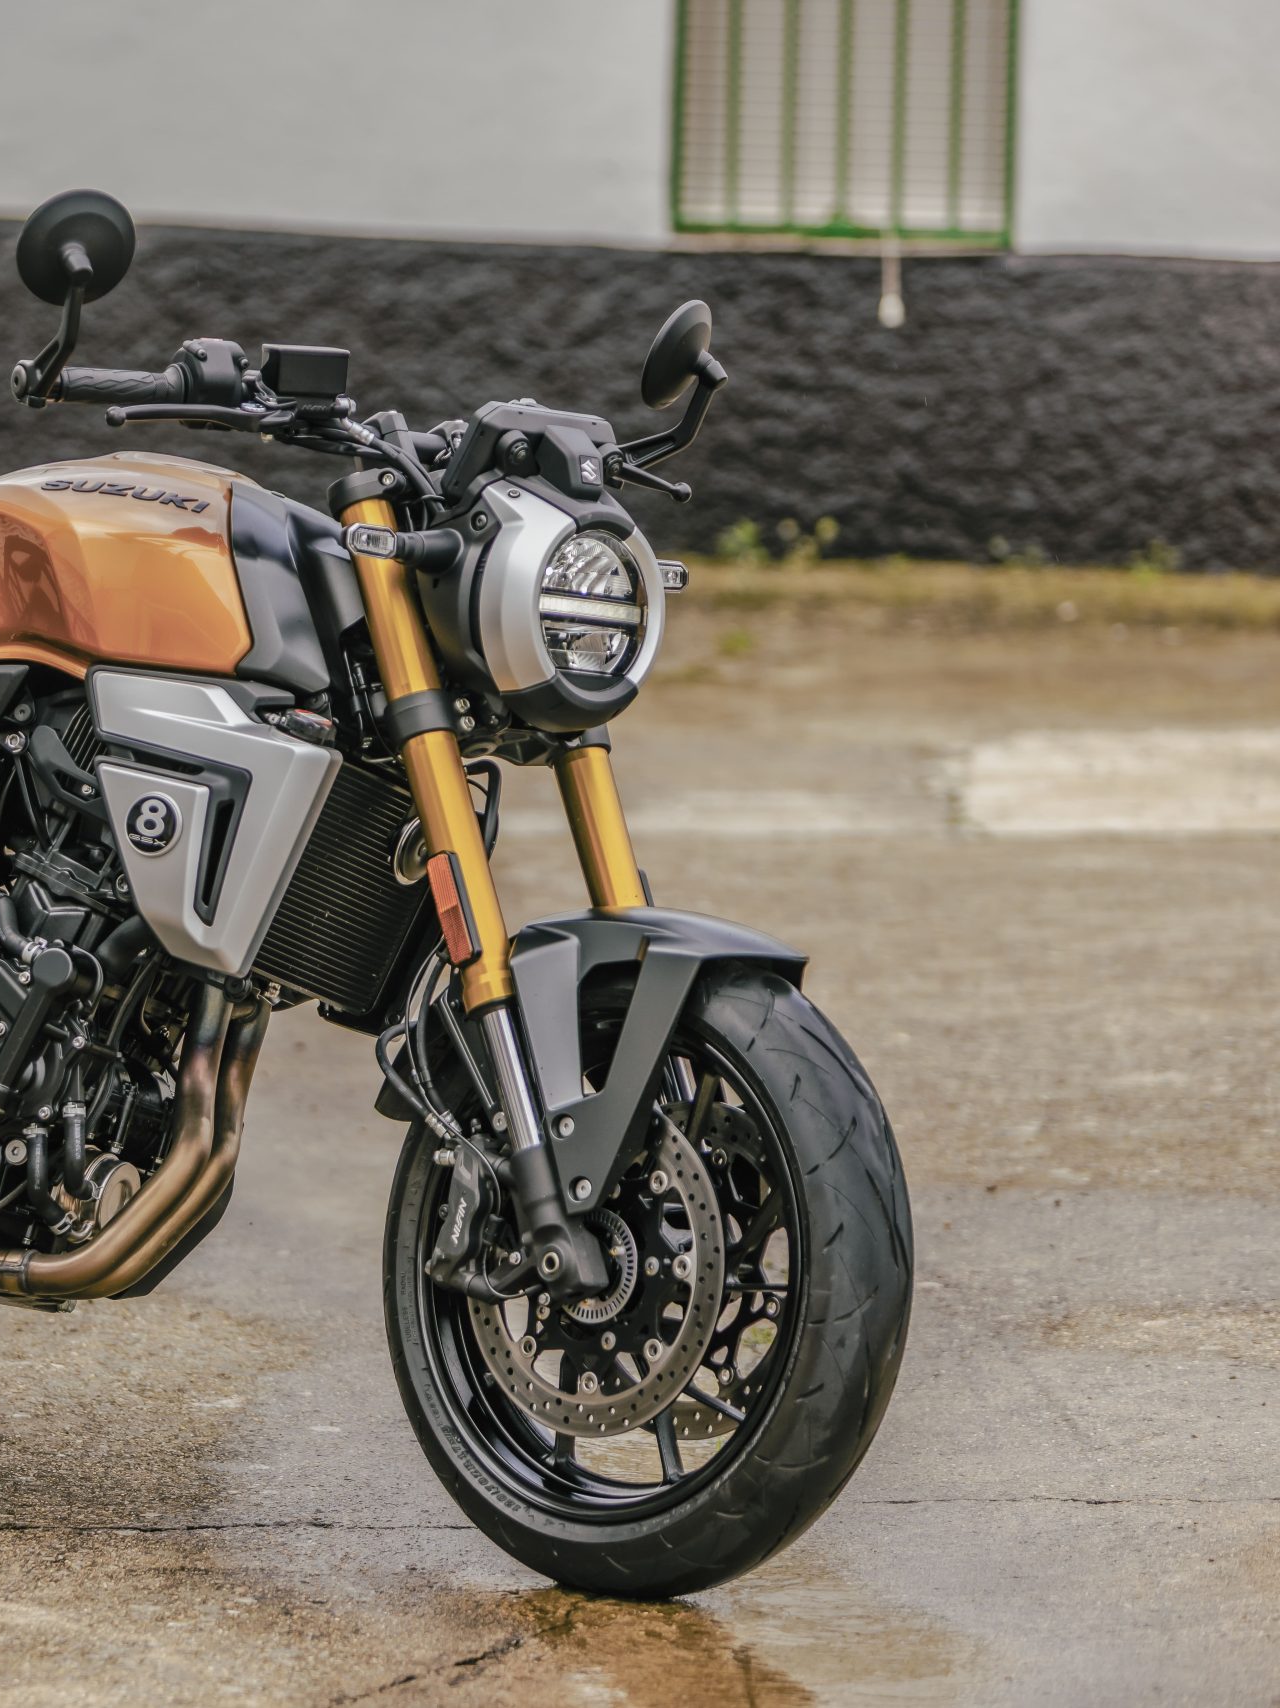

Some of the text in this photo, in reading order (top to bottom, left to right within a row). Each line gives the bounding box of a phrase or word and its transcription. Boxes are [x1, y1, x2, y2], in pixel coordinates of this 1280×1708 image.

[41, 480, 210, 513] SUZUKI
[136, 798, 167, 837] 8
[128, 833, 167, 847] GSX
